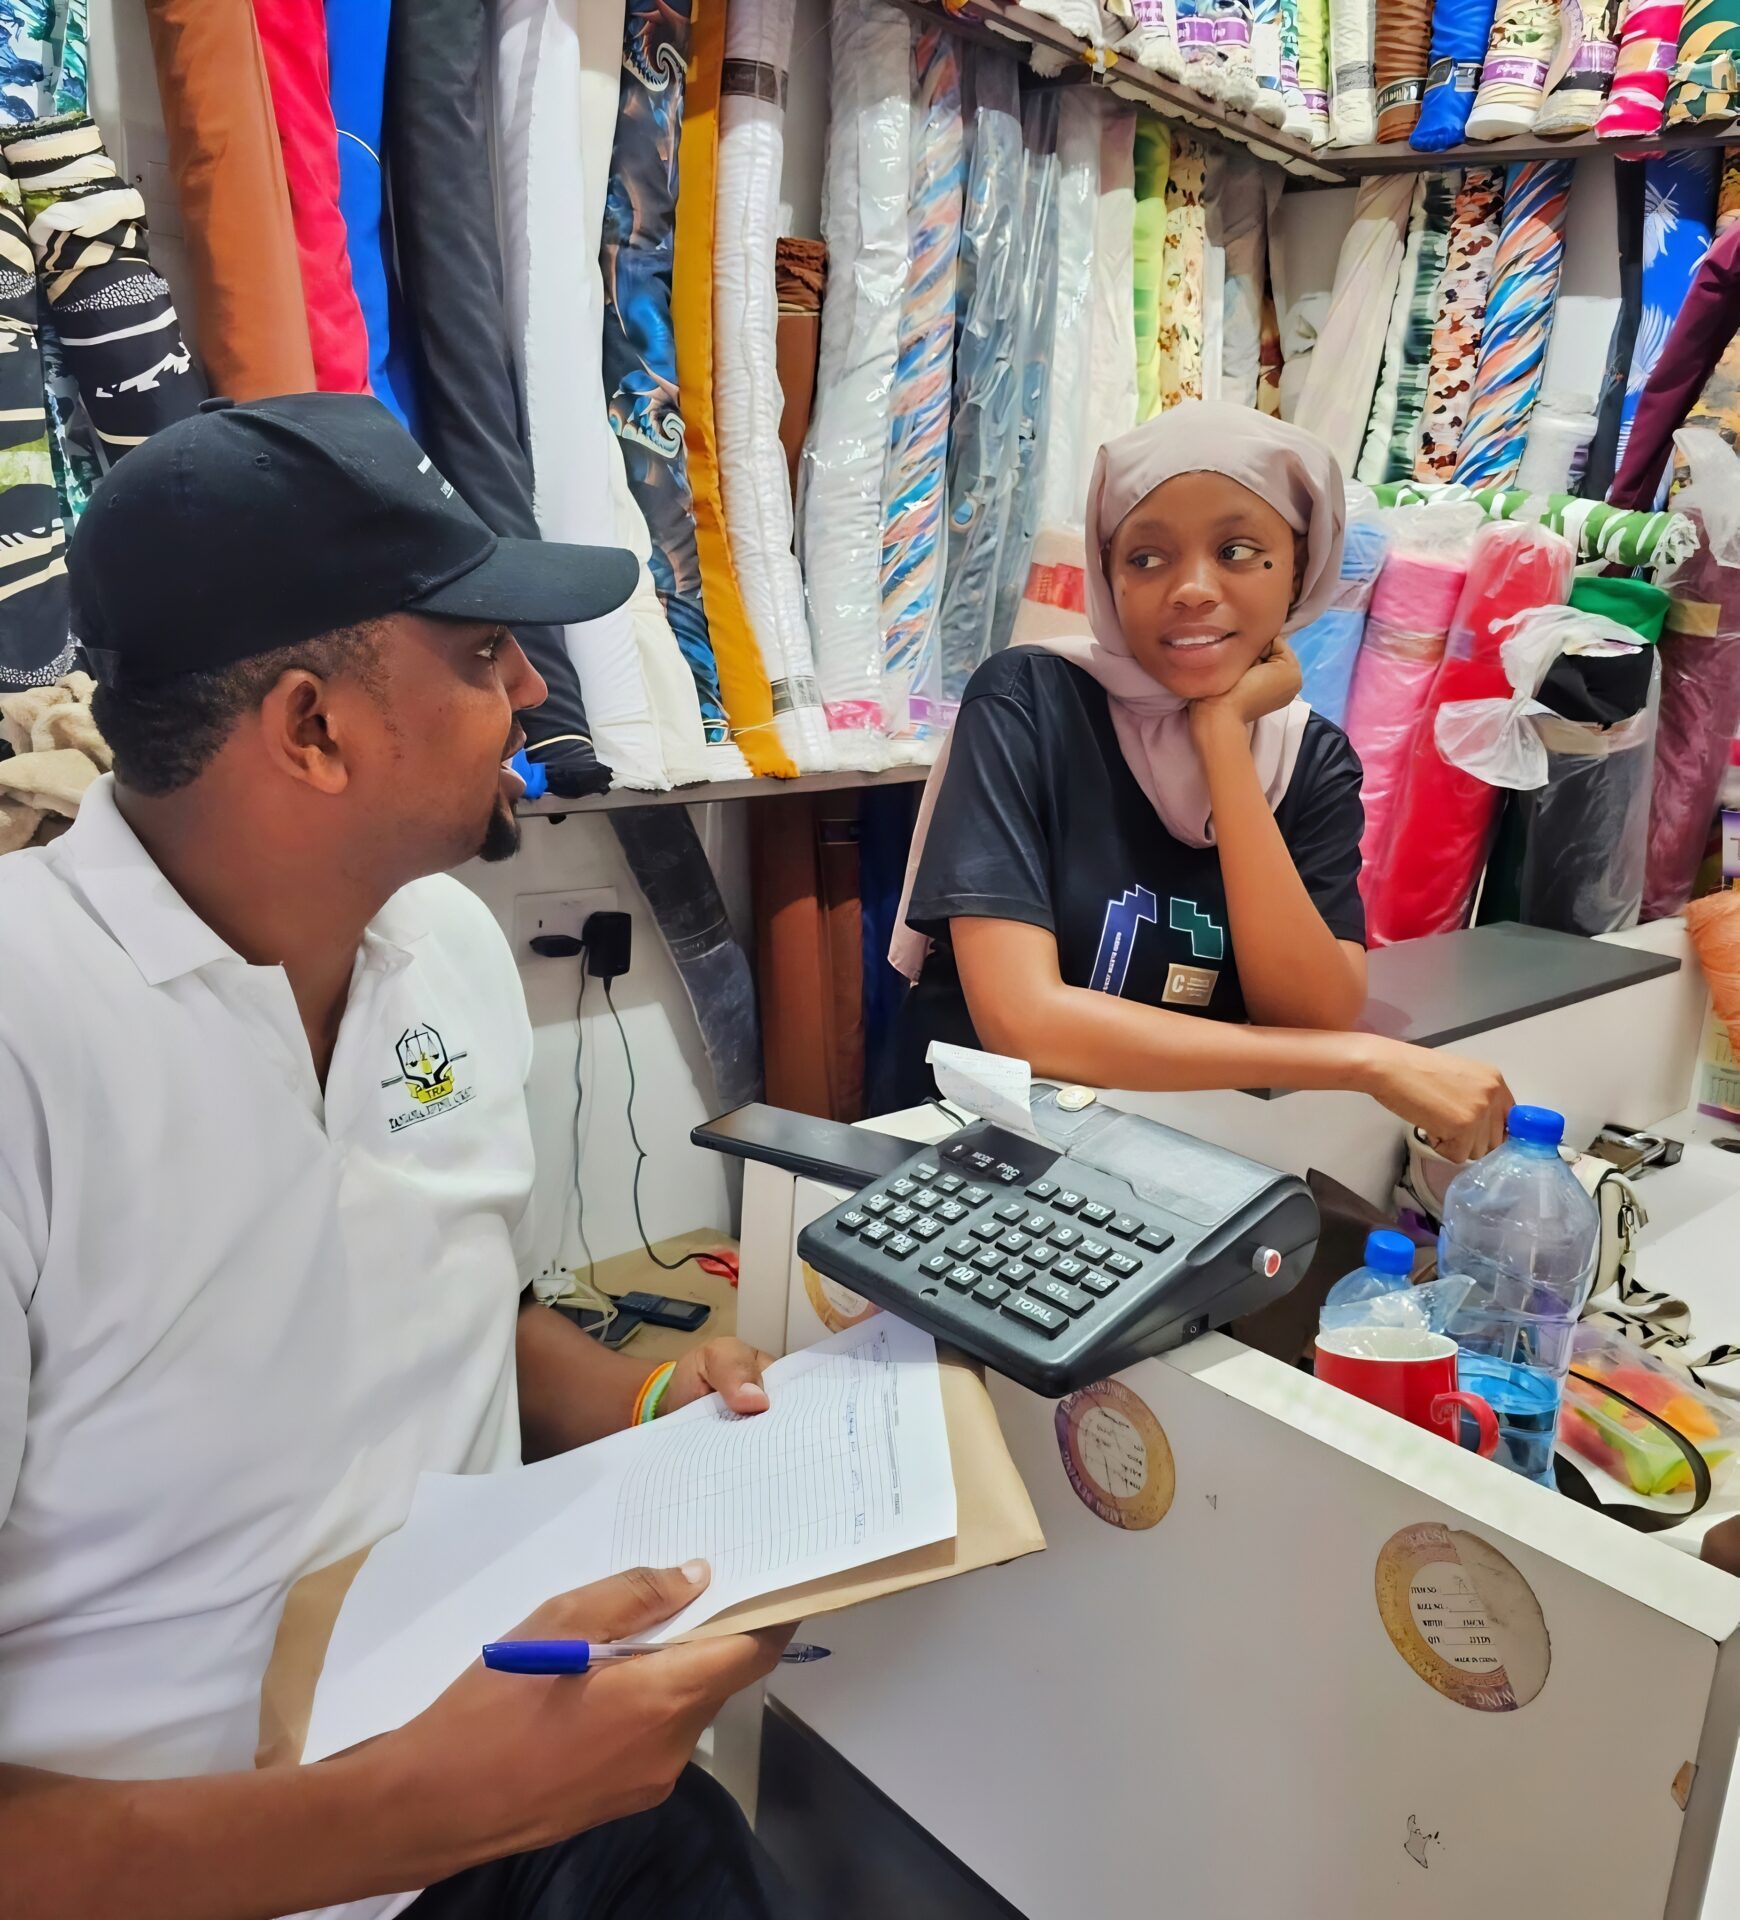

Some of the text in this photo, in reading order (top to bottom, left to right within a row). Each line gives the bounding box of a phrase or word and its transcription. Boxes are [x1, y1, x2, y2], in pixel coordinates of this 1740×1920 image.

[425, 1087, 446, 1099] TRA
[971, 1151, 995, 1164] MODE
[996, 1162, 1020, 1177] PRC
[894, 1178, 914, 1189] D7
[1038, 1182, 1049, 1191] C
[1003, 1203, 1020, 1214] 7
[1085, 1202, 1112, 1216] QTY
[980, 1221, 996, 1232] 4
[1030, 1215, 1045, 1227] 8
[1007, 1232, 1023, 1243] 5
[1057, 1228, 1072, 1240] 9
[957, 1239, 970, 1249] 1
[1081, 1239, 1108, 1255] PLU
[980, 1251, 998, 1263] 2
[1034, 1246, 1049, 1258] 6
[929, 1255, 945, 1266] 0
[1058, 1258, 1081, 1273] D1
[1109, 1252, 1137, 1269] PY1
[952, 1266, 975, 1281] 00
[1009, 1263, 1024, 1275] 3
[1085, 1271, 1113, 1288] PY2
[1046, 1282, 1071, 1300] STL
[1014, 1296, 1052, 1322] TOTAL
